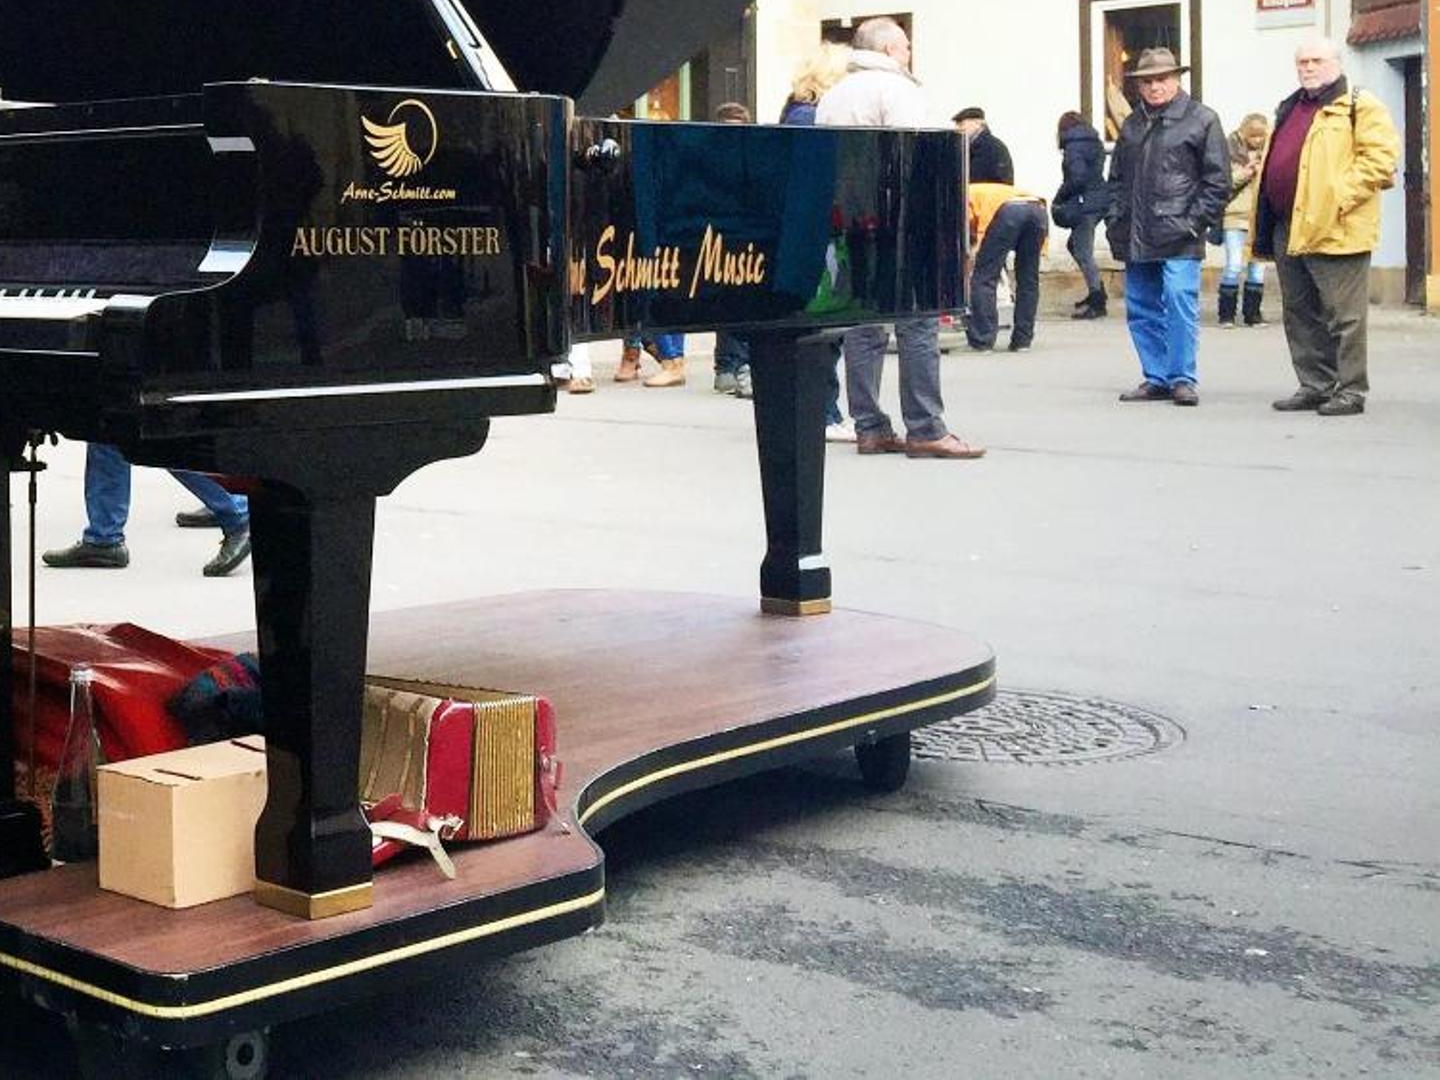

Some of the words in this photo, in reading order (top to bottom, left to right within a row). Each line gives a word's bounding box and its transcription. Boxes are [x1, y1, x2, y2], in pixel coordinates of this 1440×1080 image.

[340, 181, 456, 204] Arne-Schmitt.com
[291, 226, 390, 257] AUGUST
[398, 220, 501, 256] FÖRSTER
[591, 224, 681, 305] Schmitt
[688, 222, 766, 299] Music
